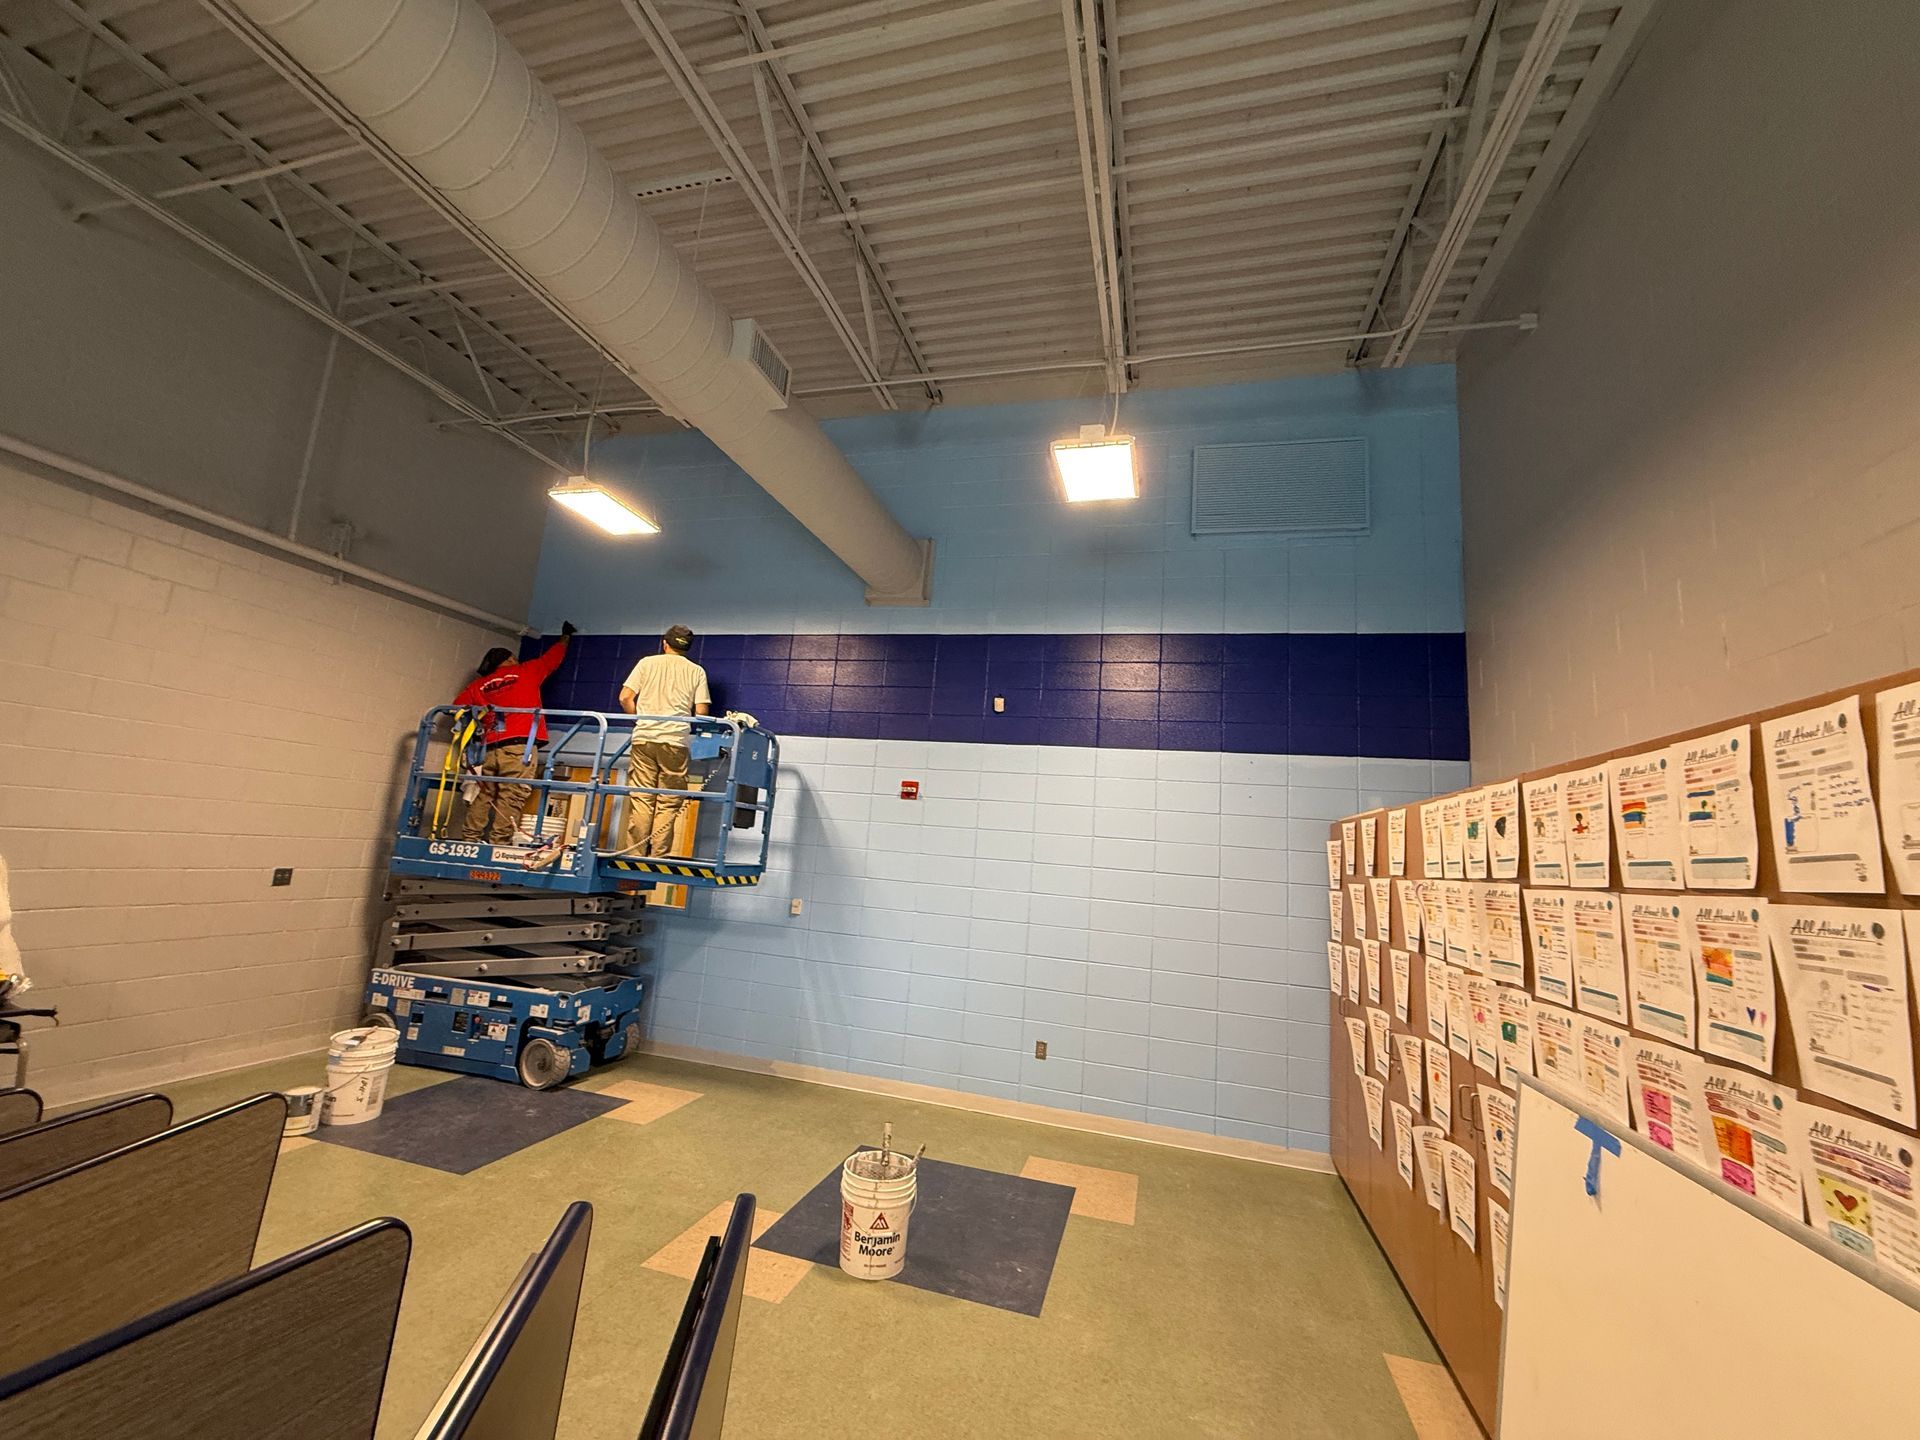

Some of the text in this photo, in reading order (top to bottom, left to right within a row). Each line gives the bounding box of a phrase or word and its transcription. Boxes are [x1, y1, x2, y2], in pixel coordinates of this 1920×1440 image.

[1775, 730, 1791, 747] All
[1792, 726, 1820, 743] About
[428, 841, 480, 859] GS-1932
[1790, 919, 1816, 935] All
[1816, 921, 1848, 937] About
[371, 972, 416, 989] E-DRIVE
[1704, 1076, 1726, 1091] All
[1728, 1081, 1754, 1100] About
[1808, 1121, 1833, 1140] All
[1834, 1129, 1872, 1153] About
[854, 1231, 901, 1247] Benjamin
